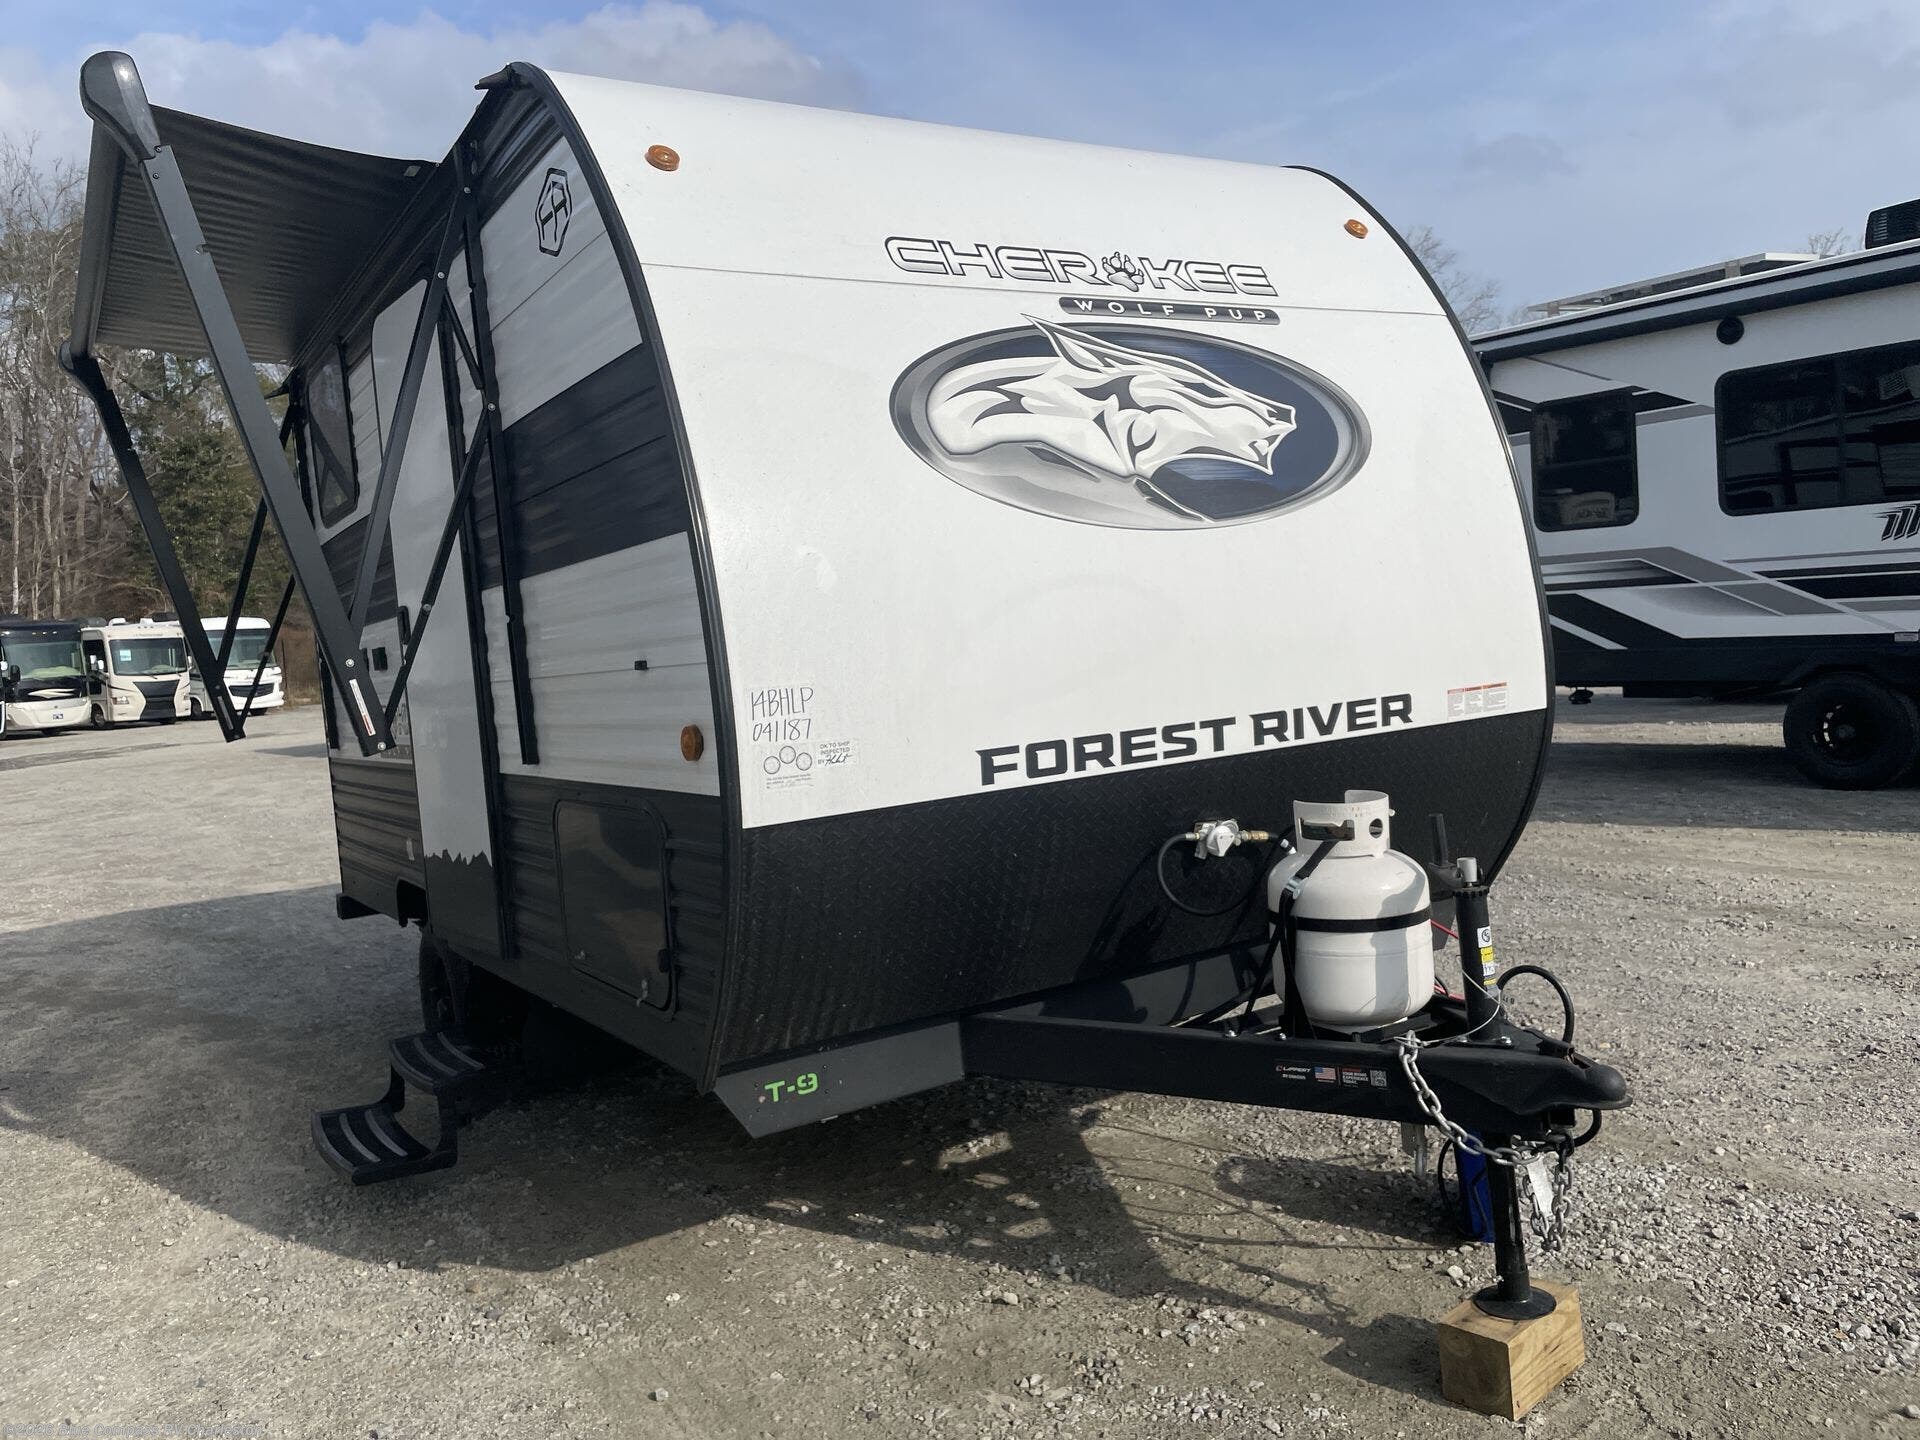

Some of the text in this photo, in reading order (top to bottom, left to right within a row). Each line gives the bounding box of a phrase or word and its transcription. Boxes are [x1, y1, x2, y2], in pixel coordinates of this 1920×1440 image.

[1073, 299, 1266, 321] WOLF PUP
[752, 718, 812, 742] 041187
[975, 716, 1237, 786] FOREST
[1248, 693, 1414, 746] RIVER
[764, 1072, 819, 1103] T-9
